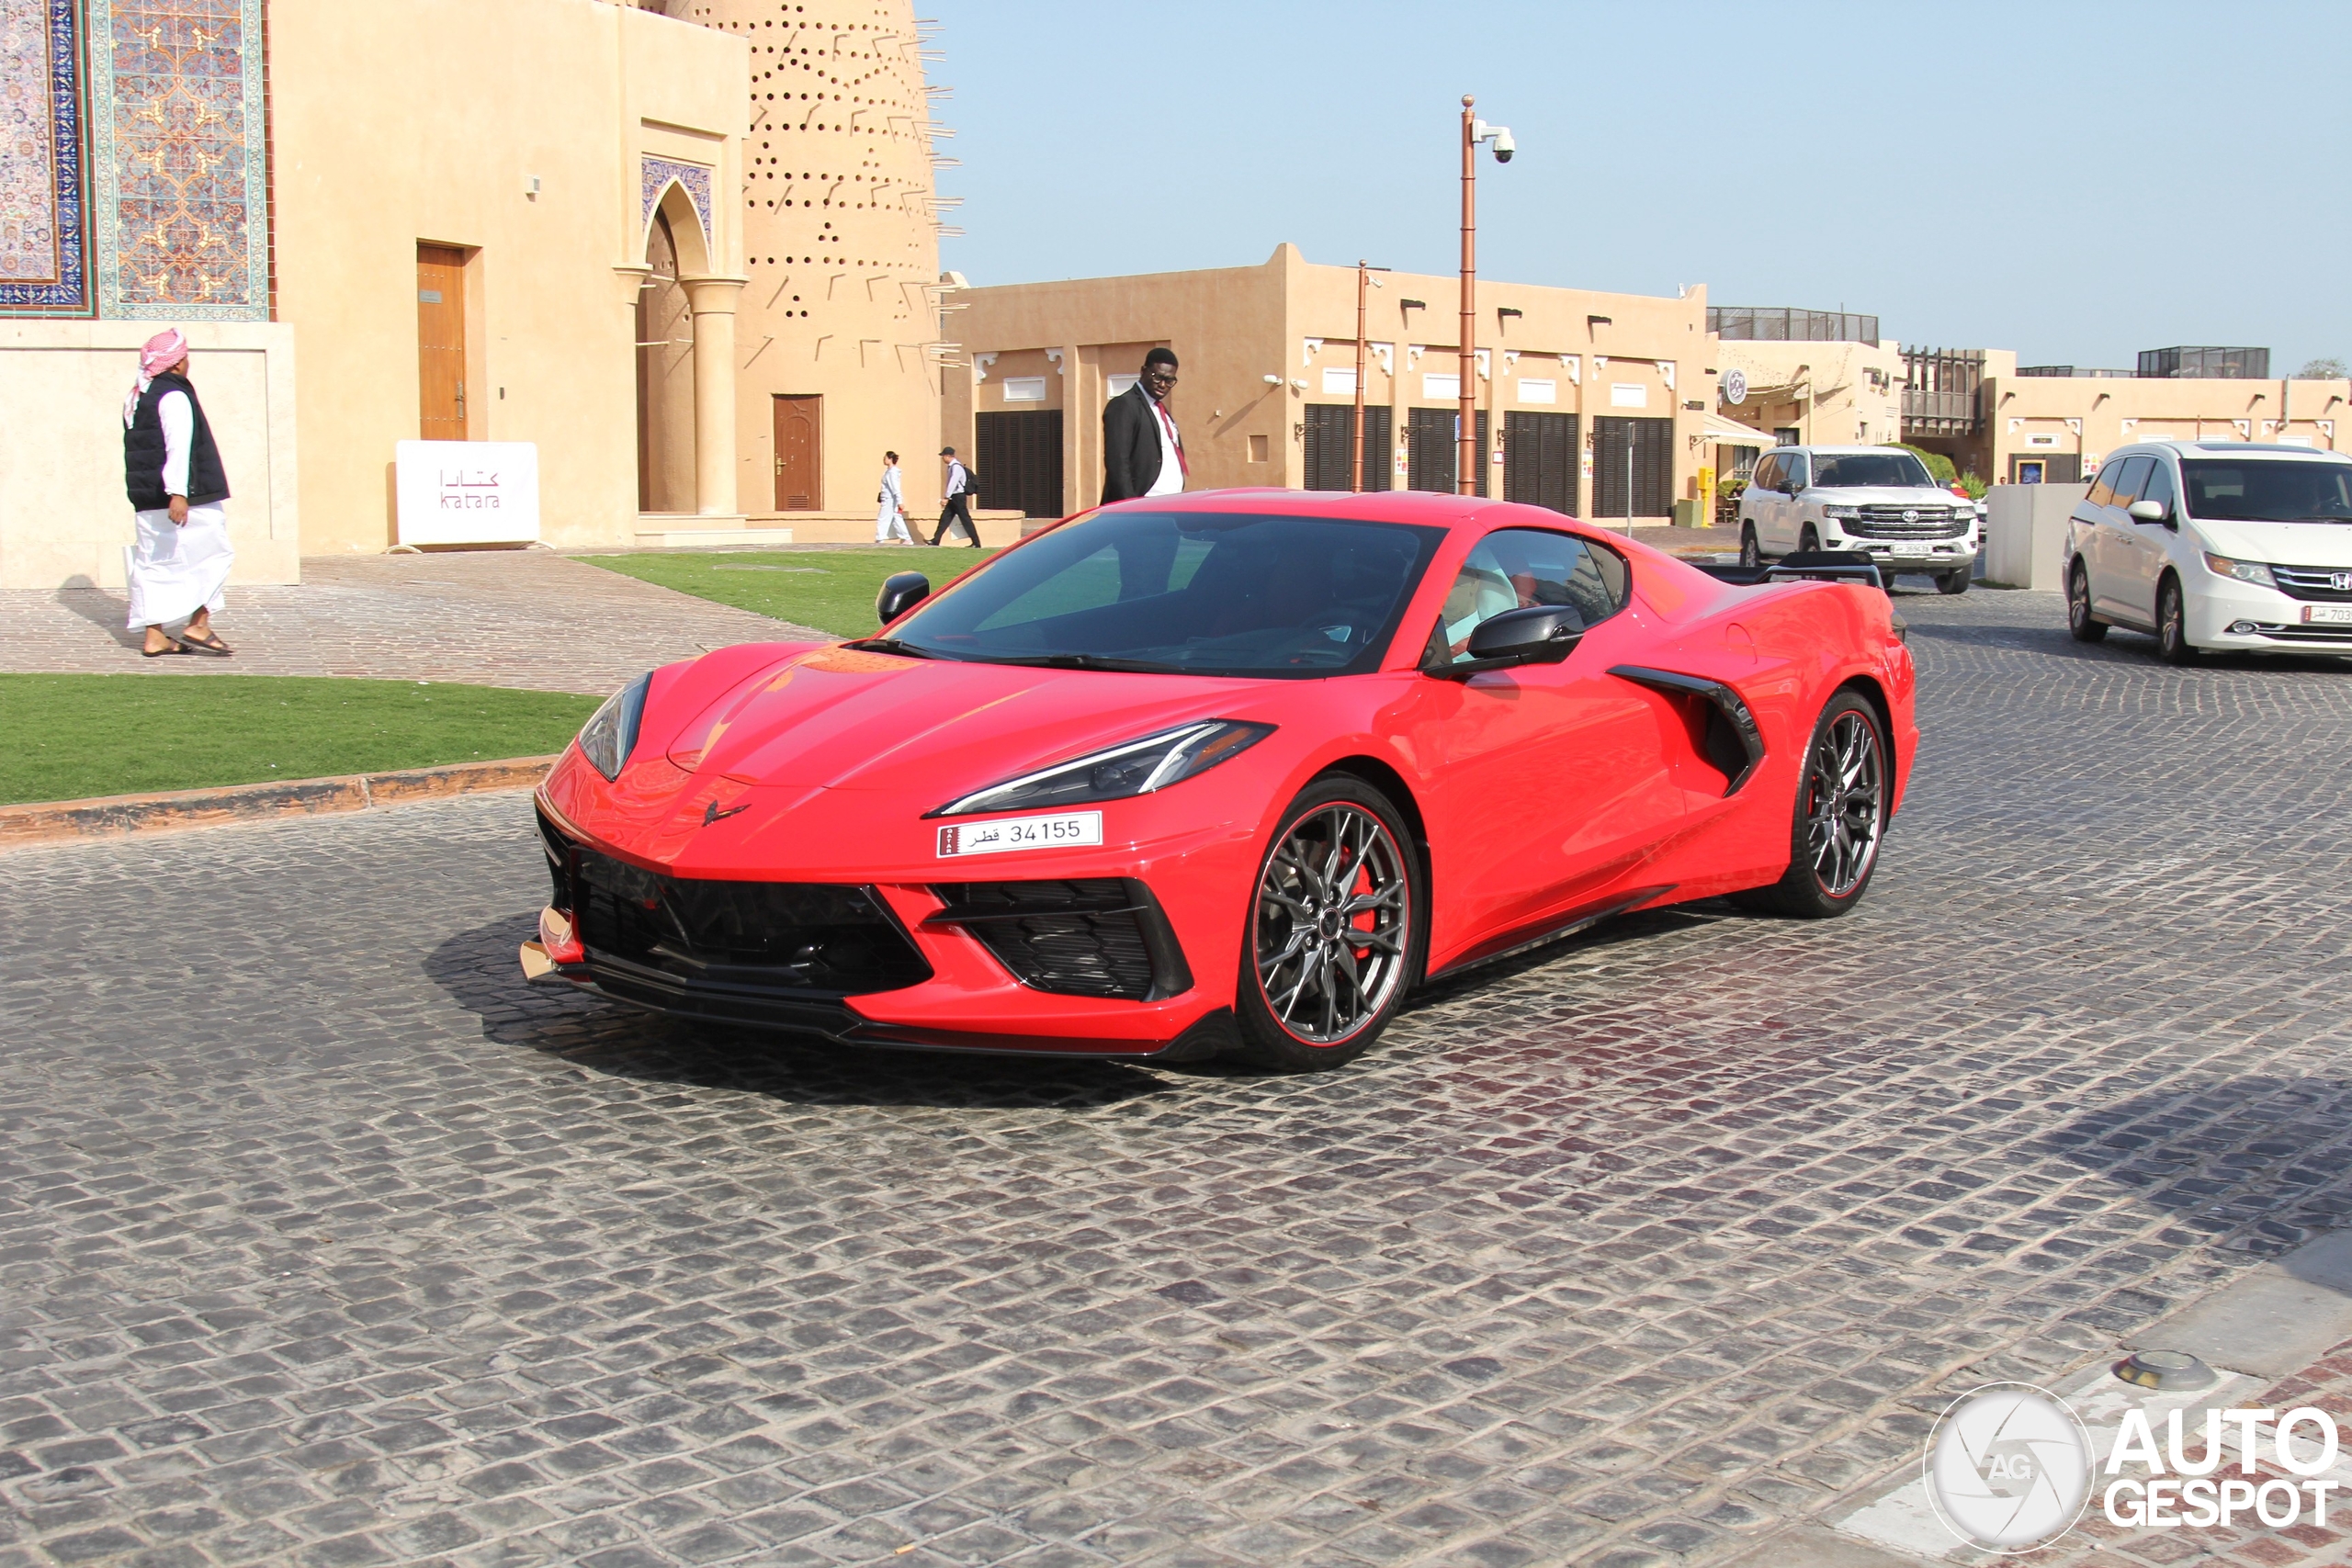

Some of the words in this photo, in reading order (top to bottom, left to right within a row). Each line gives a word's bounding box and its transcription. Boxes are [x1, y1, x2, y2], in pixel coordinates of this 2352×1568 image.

[440, 469, 499, 487] كتارا
[441, 491, 500, 509] katara
[967, 829, 1000, 847] قطر
[1011, 821, 1080, 842] 34155
